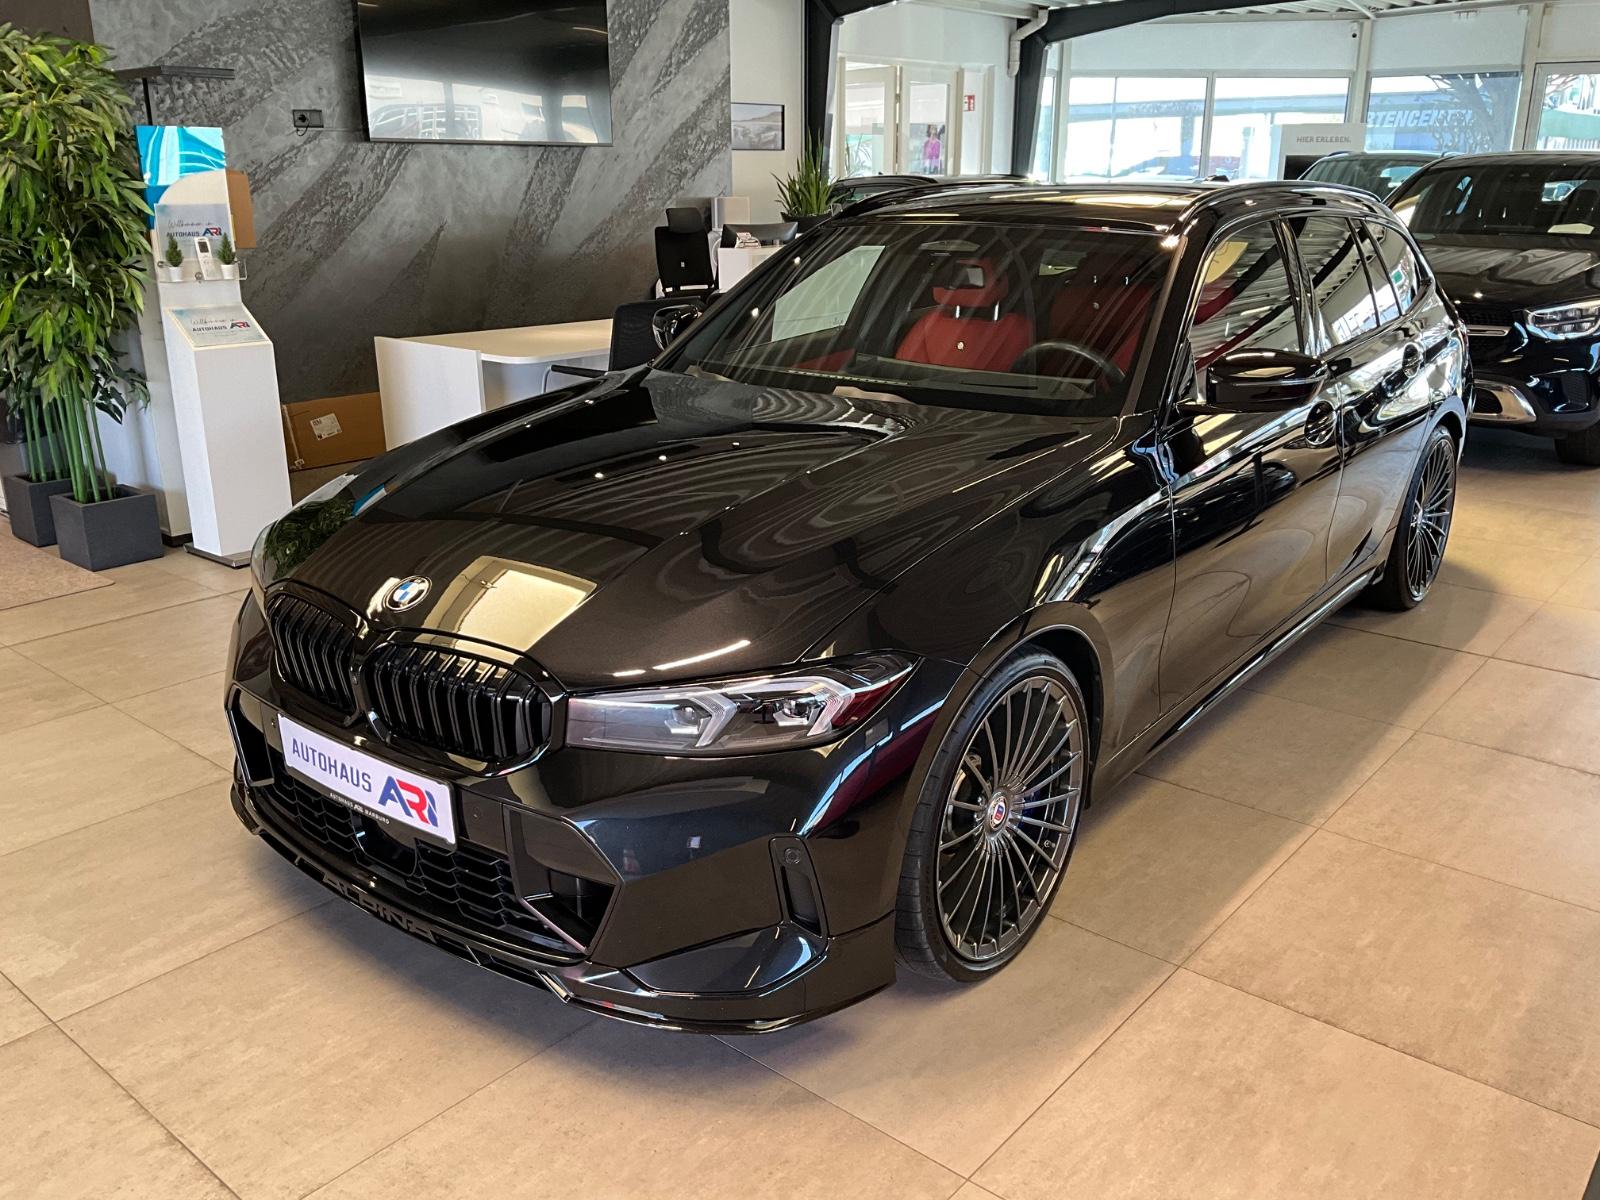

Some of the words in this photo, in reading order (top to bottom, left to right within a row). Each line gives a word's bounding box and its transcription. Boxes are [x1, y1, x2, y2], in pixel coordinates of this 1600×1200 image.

[202, 227, 222, 237] ARI
[230, 321, 250, 329] ARI
[292, 738, 373, 793] AUTOHAUS
[378, 775, 438, 828] ARI
